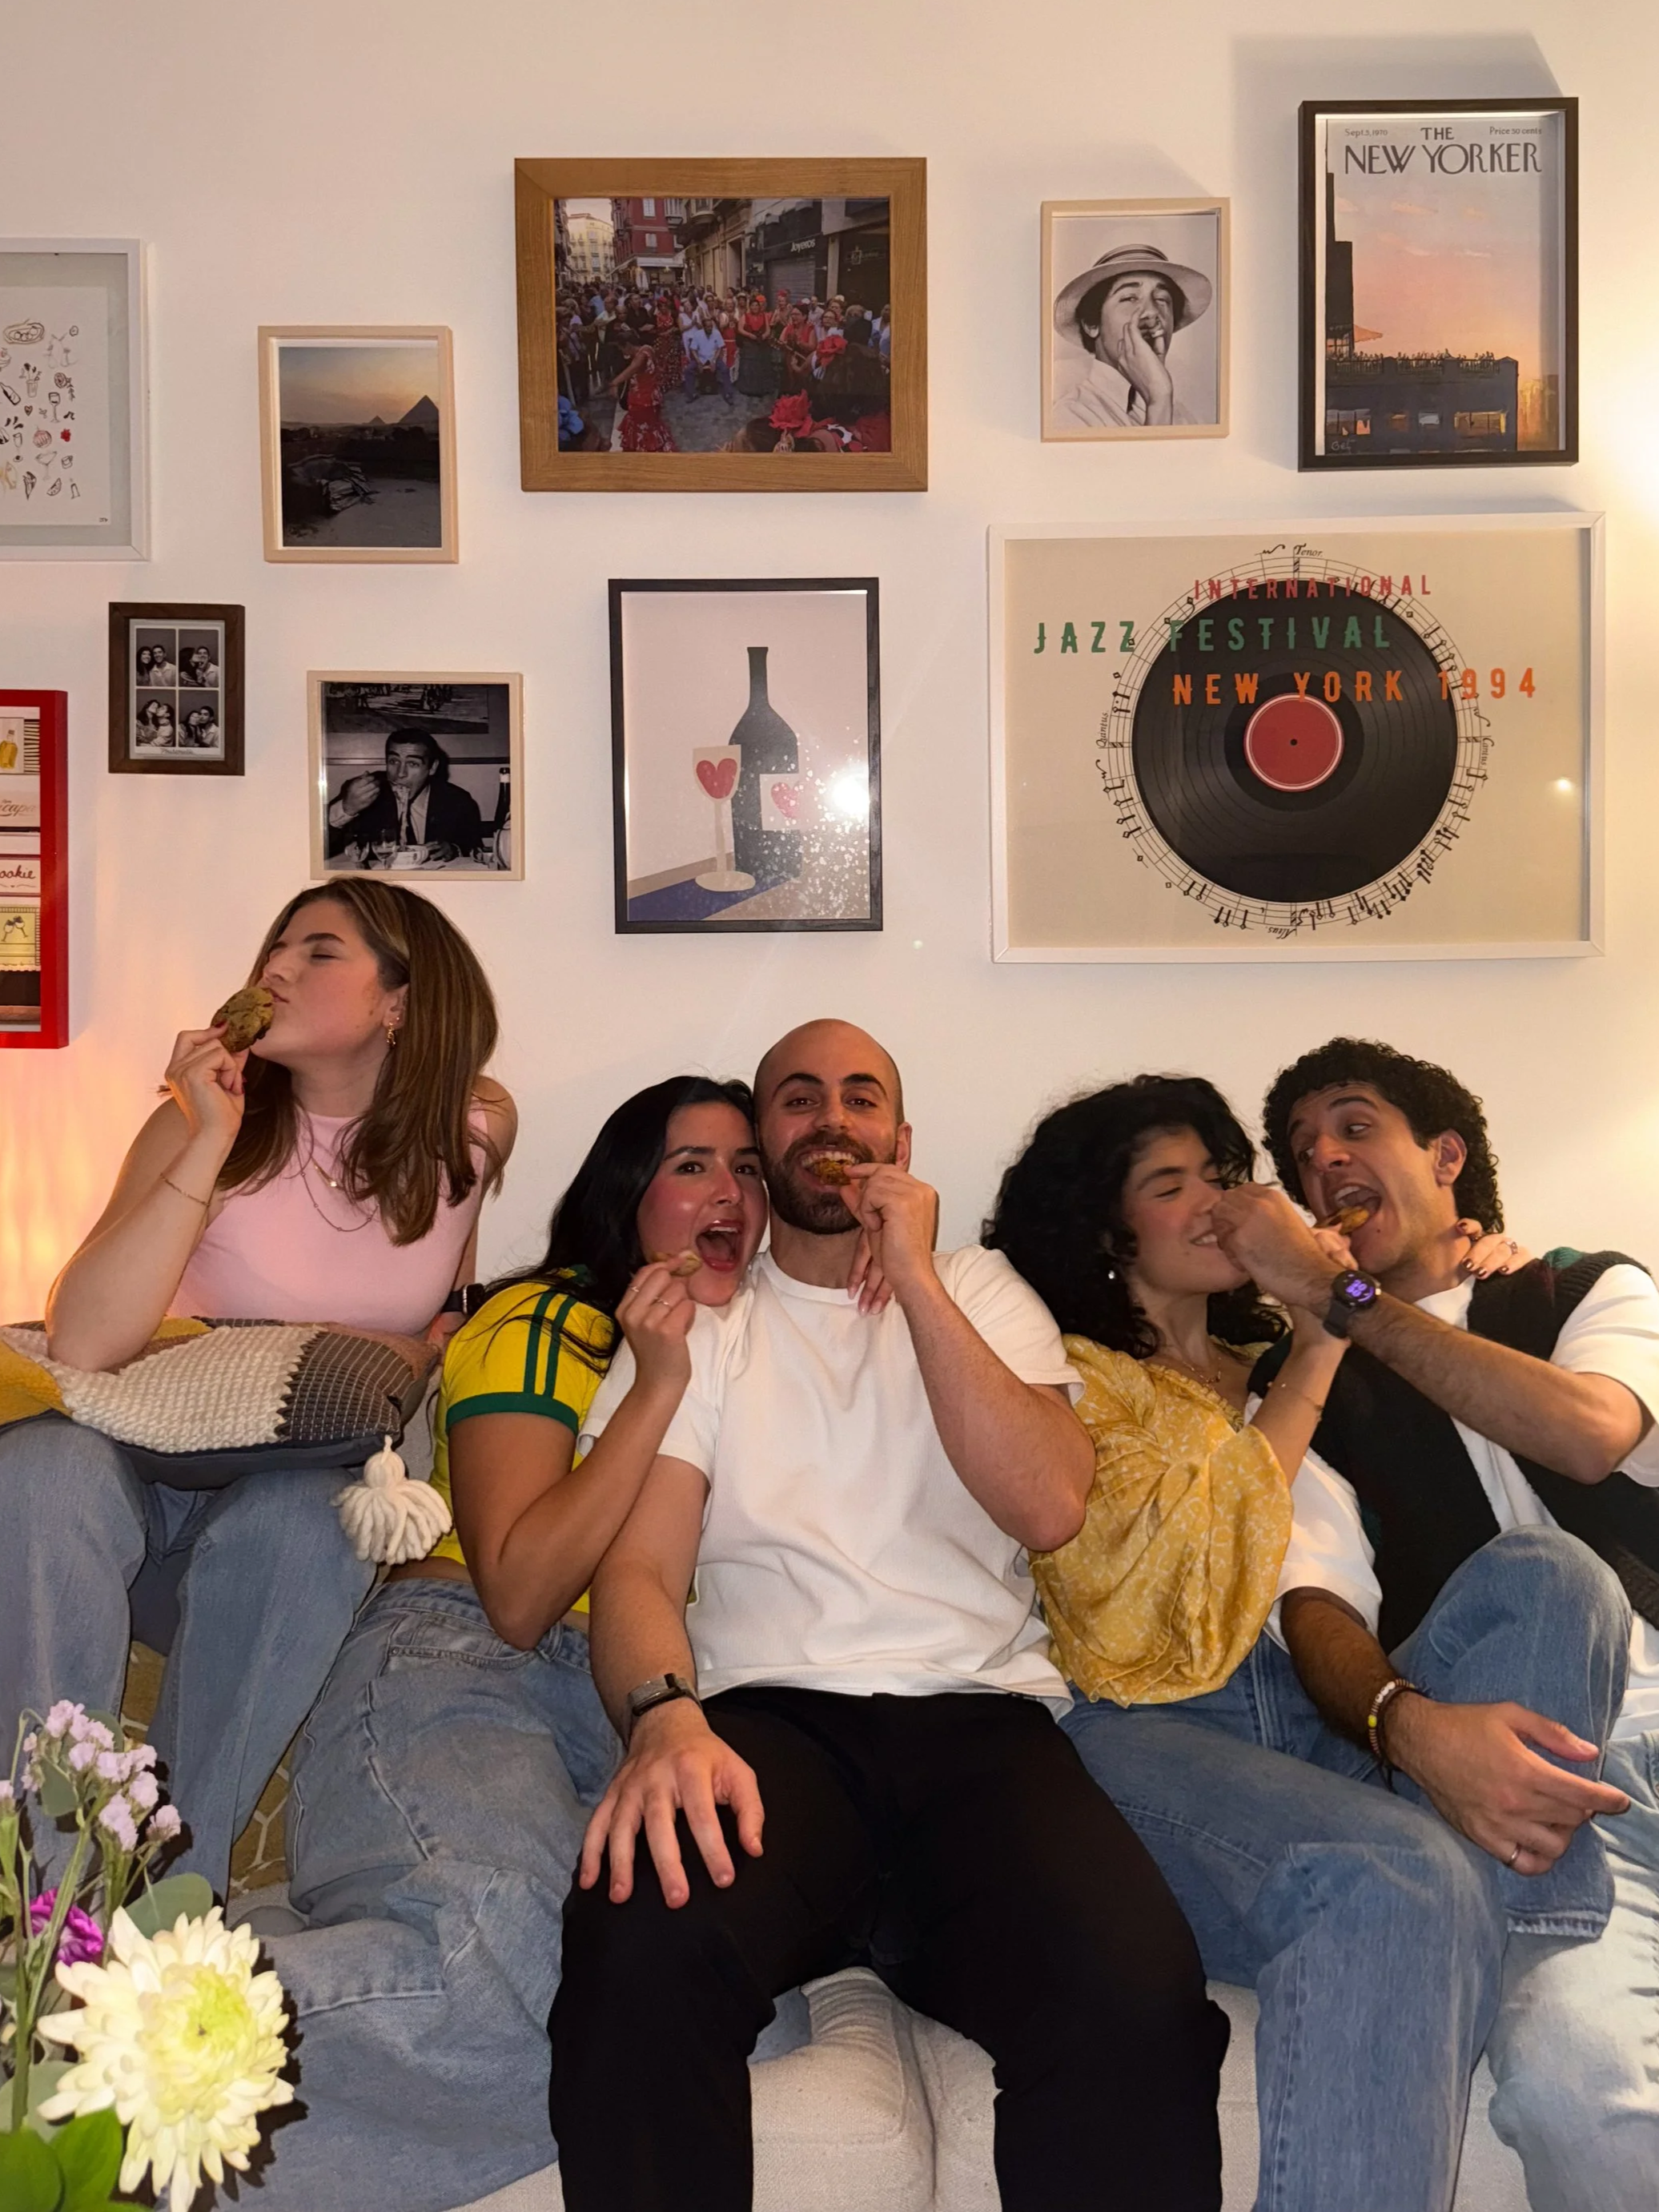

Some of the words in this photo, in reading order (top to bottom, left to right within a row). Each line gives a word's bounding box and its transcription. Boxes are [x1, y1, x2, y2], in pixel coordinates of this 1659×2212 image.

[1420, 127, 1455, 140] THE
[1489, 126, 1510, 135] Price
[1345, 144, 1416, 175] NEW
[1421, 143, 1542, 175] YORKER
[1194, 575, 1432, 600] INTERNATIONAL
[1034, 621, 1135, 654] JAZZ
[1170, 616, 1390, 652] FESTIVAL
[1172, 673, 1259, 705] NEW
[1294, 670, 1404, 702] YORK
[1437, 668, 1536, 700] 1994
